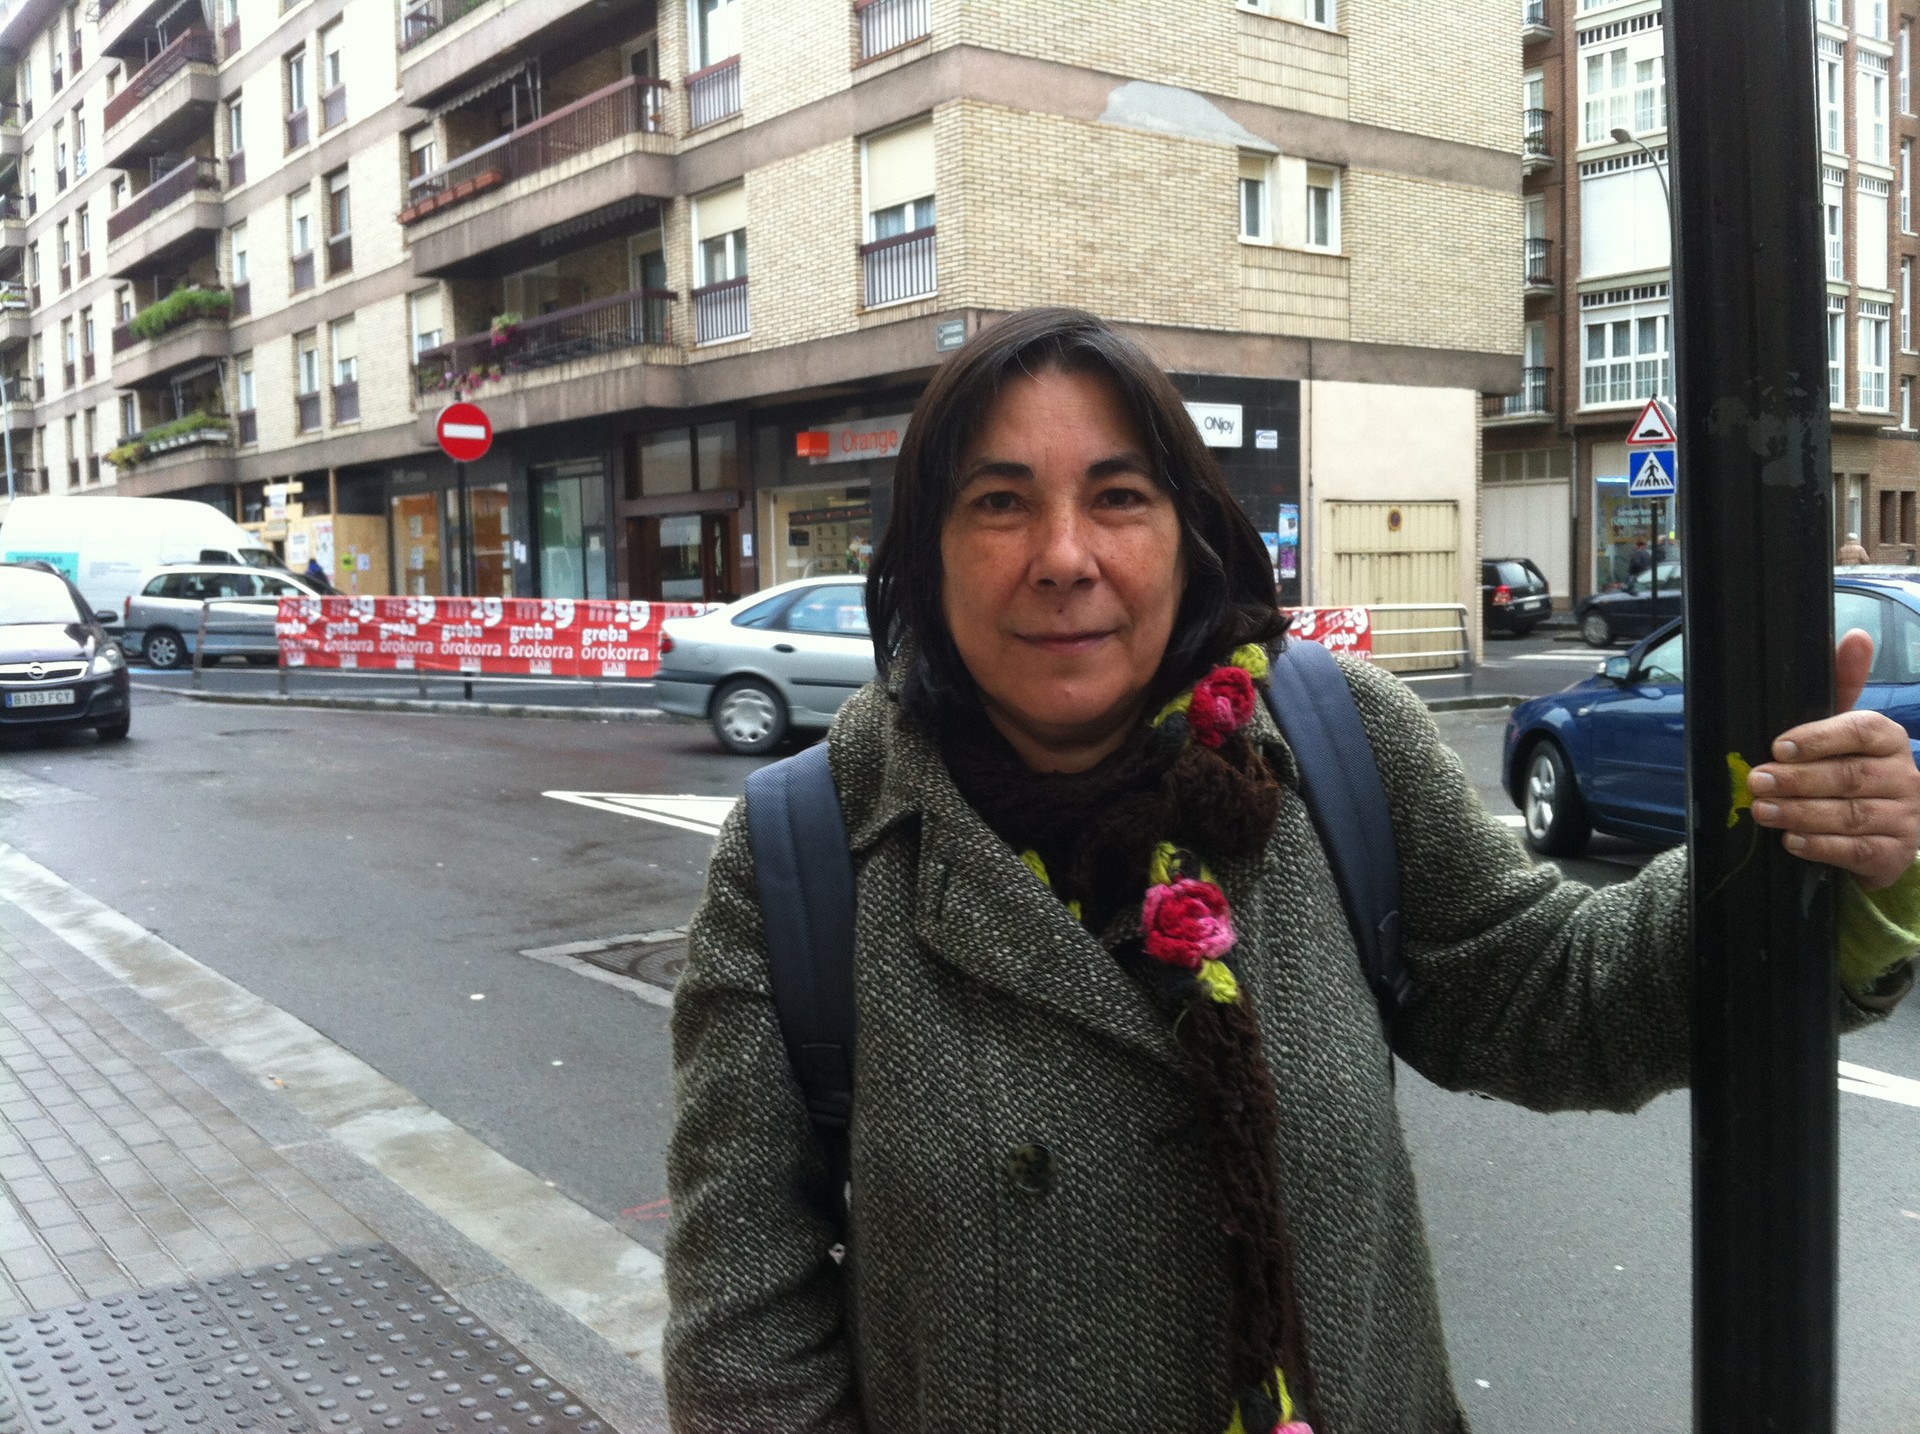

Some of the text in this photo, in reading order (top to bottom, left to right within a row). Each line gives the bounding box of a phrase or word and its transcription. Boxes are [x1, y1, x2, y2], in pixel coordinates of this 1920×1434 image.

[1204, 416, 1234, 434] ONjoy
[841, 429, 898, 454] Orange
[447, 597, 503, 627] m29
[515, 598, 576, 629] m29
[588, 600, 650, 631] m29
[441, 620, 482, 642] greba
[510, 622, 553, 643] greba
[582, 624, 628, 646] greba
[324, 637, 374, 652] orokorra
[380, 637, 434, 654] orokorra
[440, 639, 502, 657] orokorra
[509, 641, 573, 659] orokorra
[581, 643, 649, 661] orokorra
